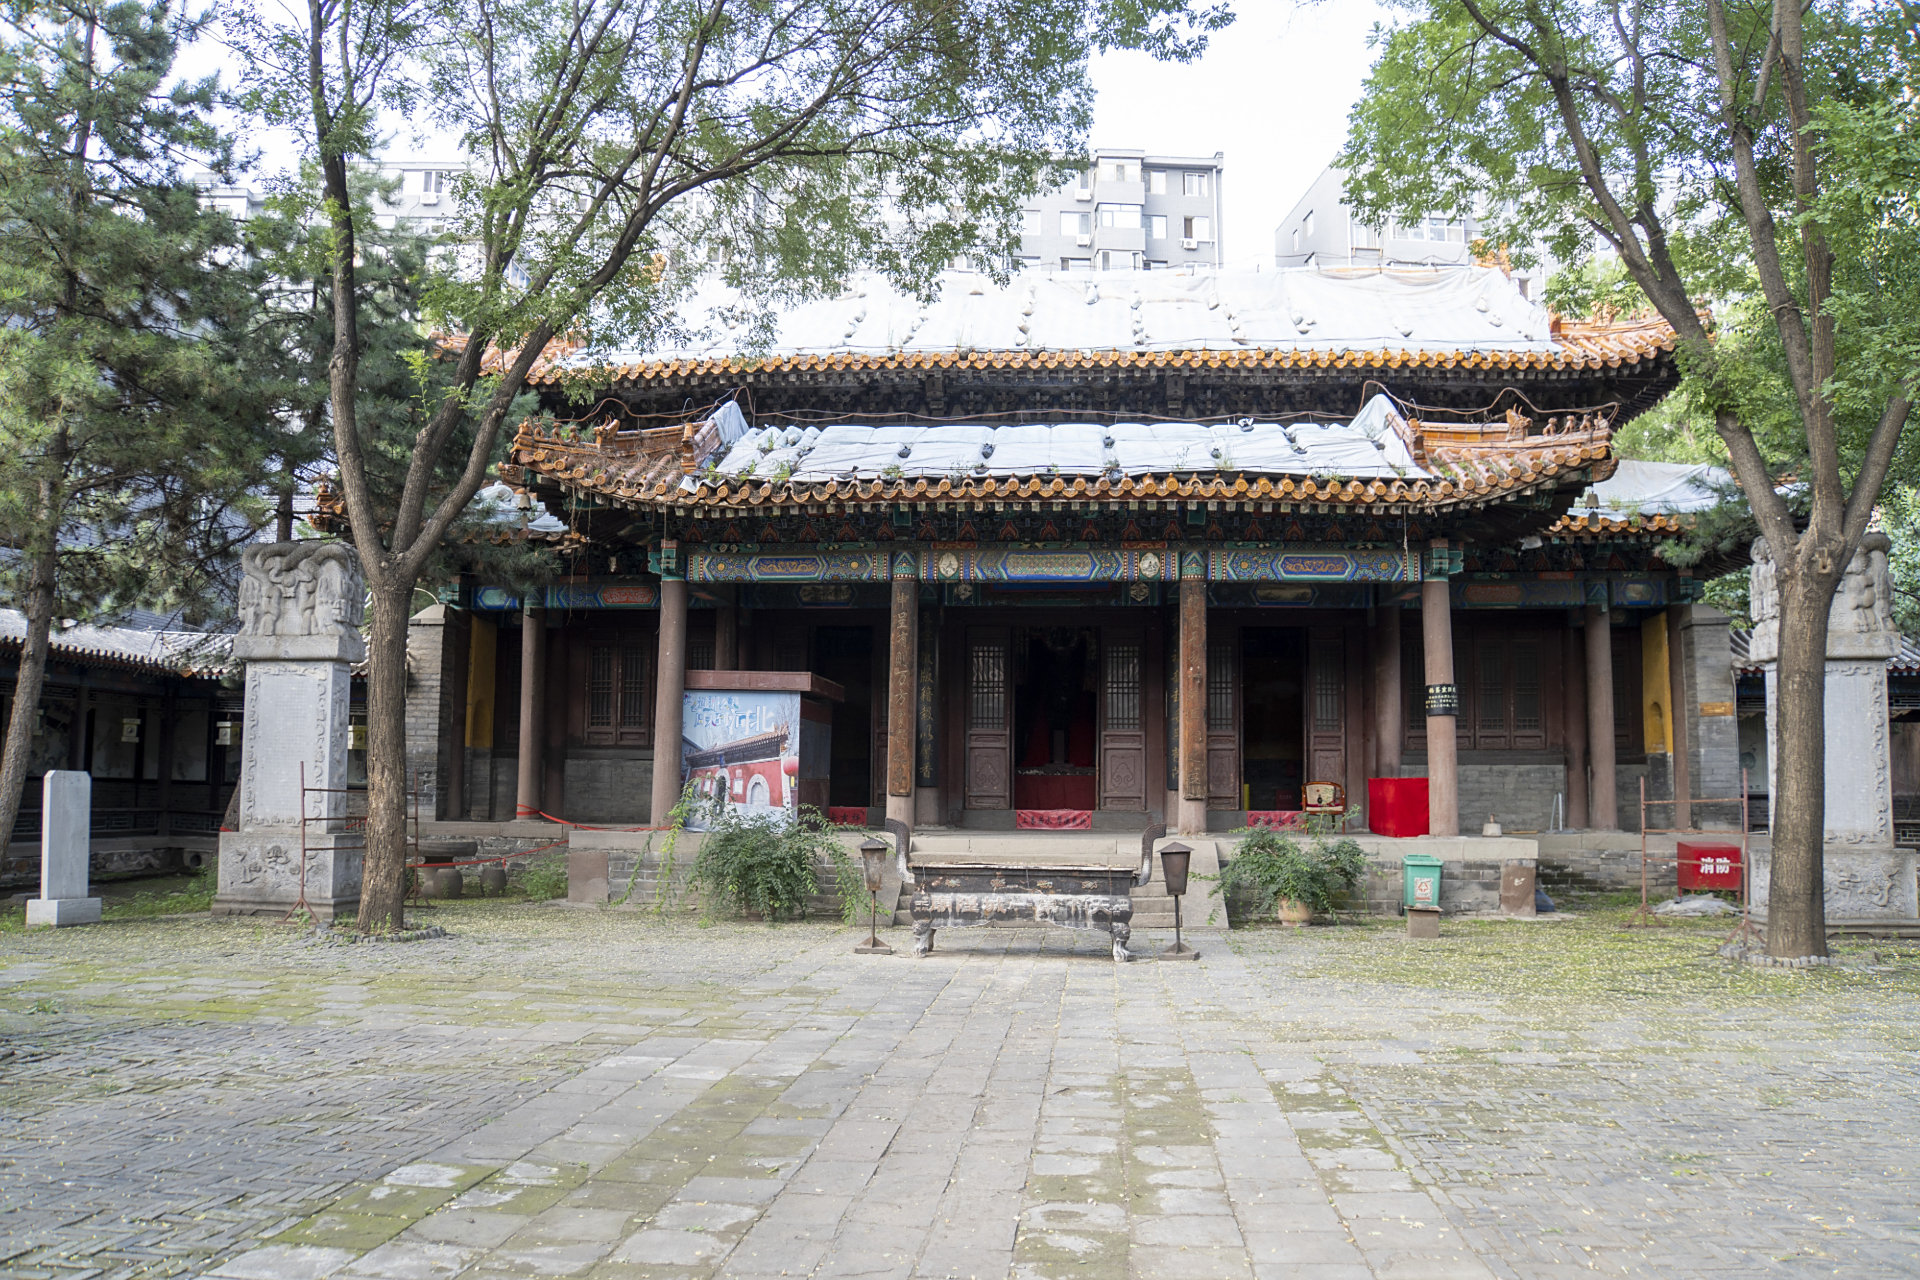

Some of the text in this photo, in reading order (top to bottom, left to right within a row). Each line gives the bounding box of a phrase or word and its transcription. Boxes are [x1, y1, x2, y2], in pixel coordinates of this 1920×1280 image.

[694, 705, 775, 735] 周末到河北
[1700, 857, 1730, 874] 消防
